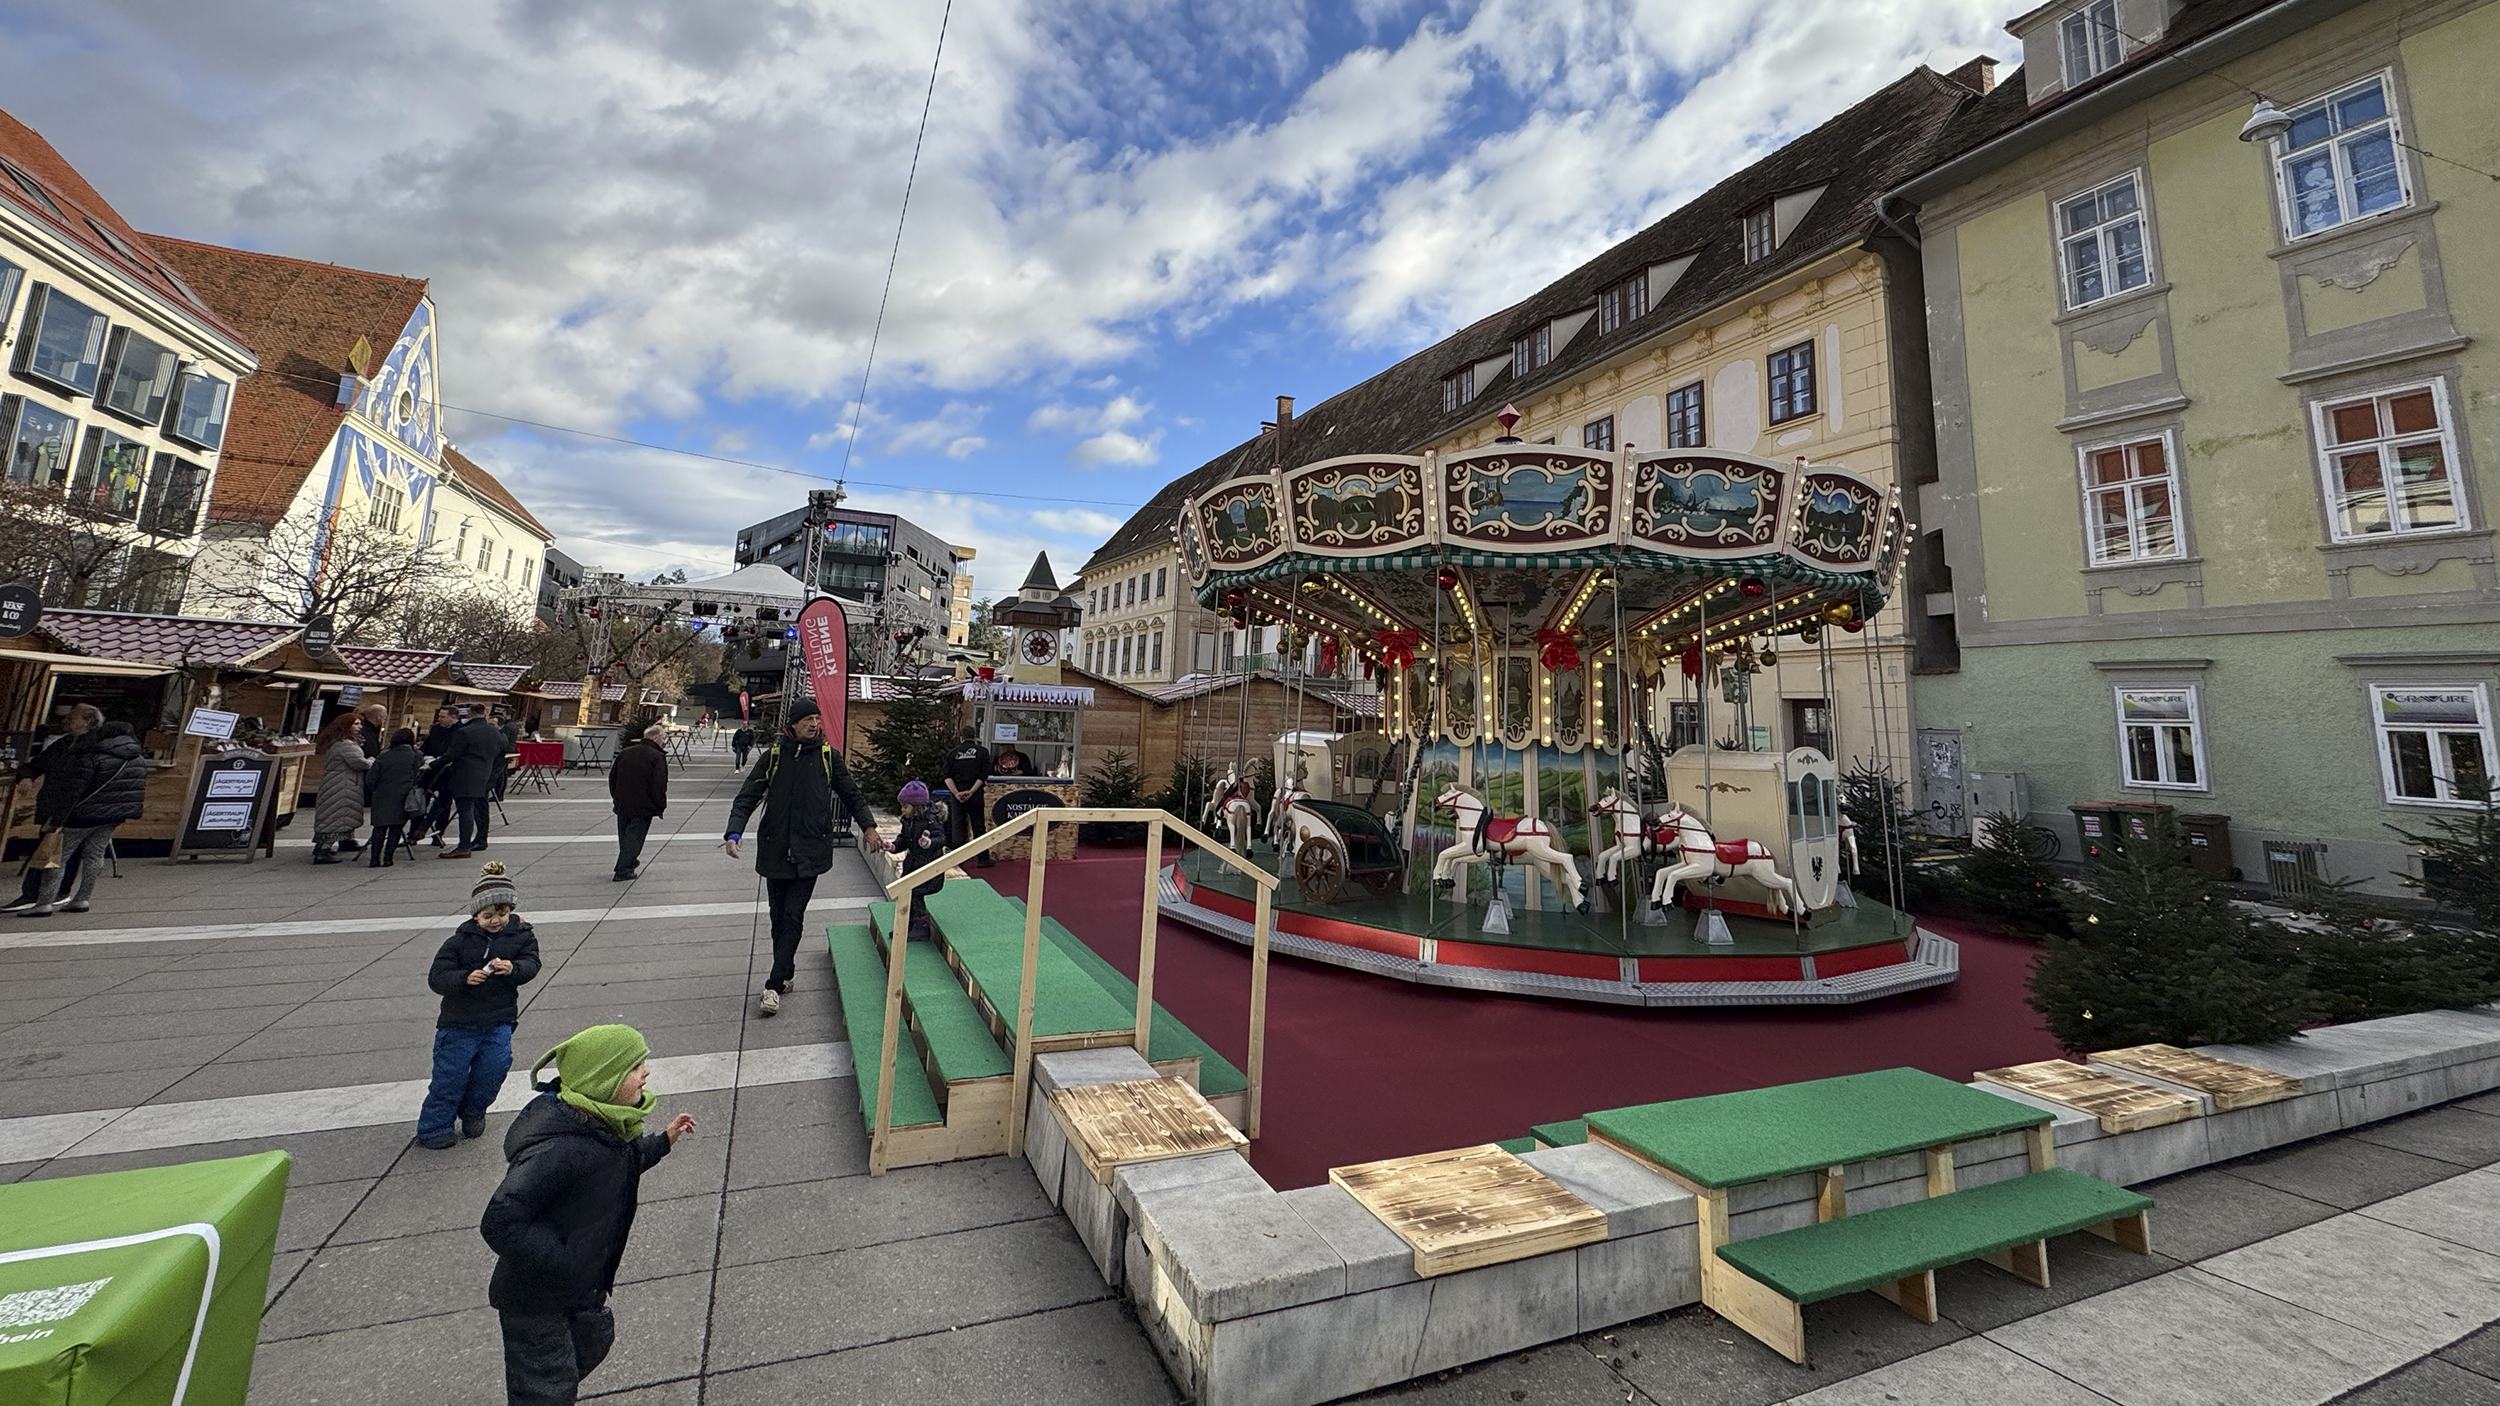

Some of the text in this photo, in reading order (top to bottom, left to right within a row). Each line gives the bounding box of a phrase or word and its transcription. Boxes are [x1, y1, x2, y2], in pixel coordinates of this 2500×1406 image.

[3, 601, 25, 611] KEKSE
[9, 611, 20, 620] CO
[2395, 695, 2470, 703] GRAVURE
